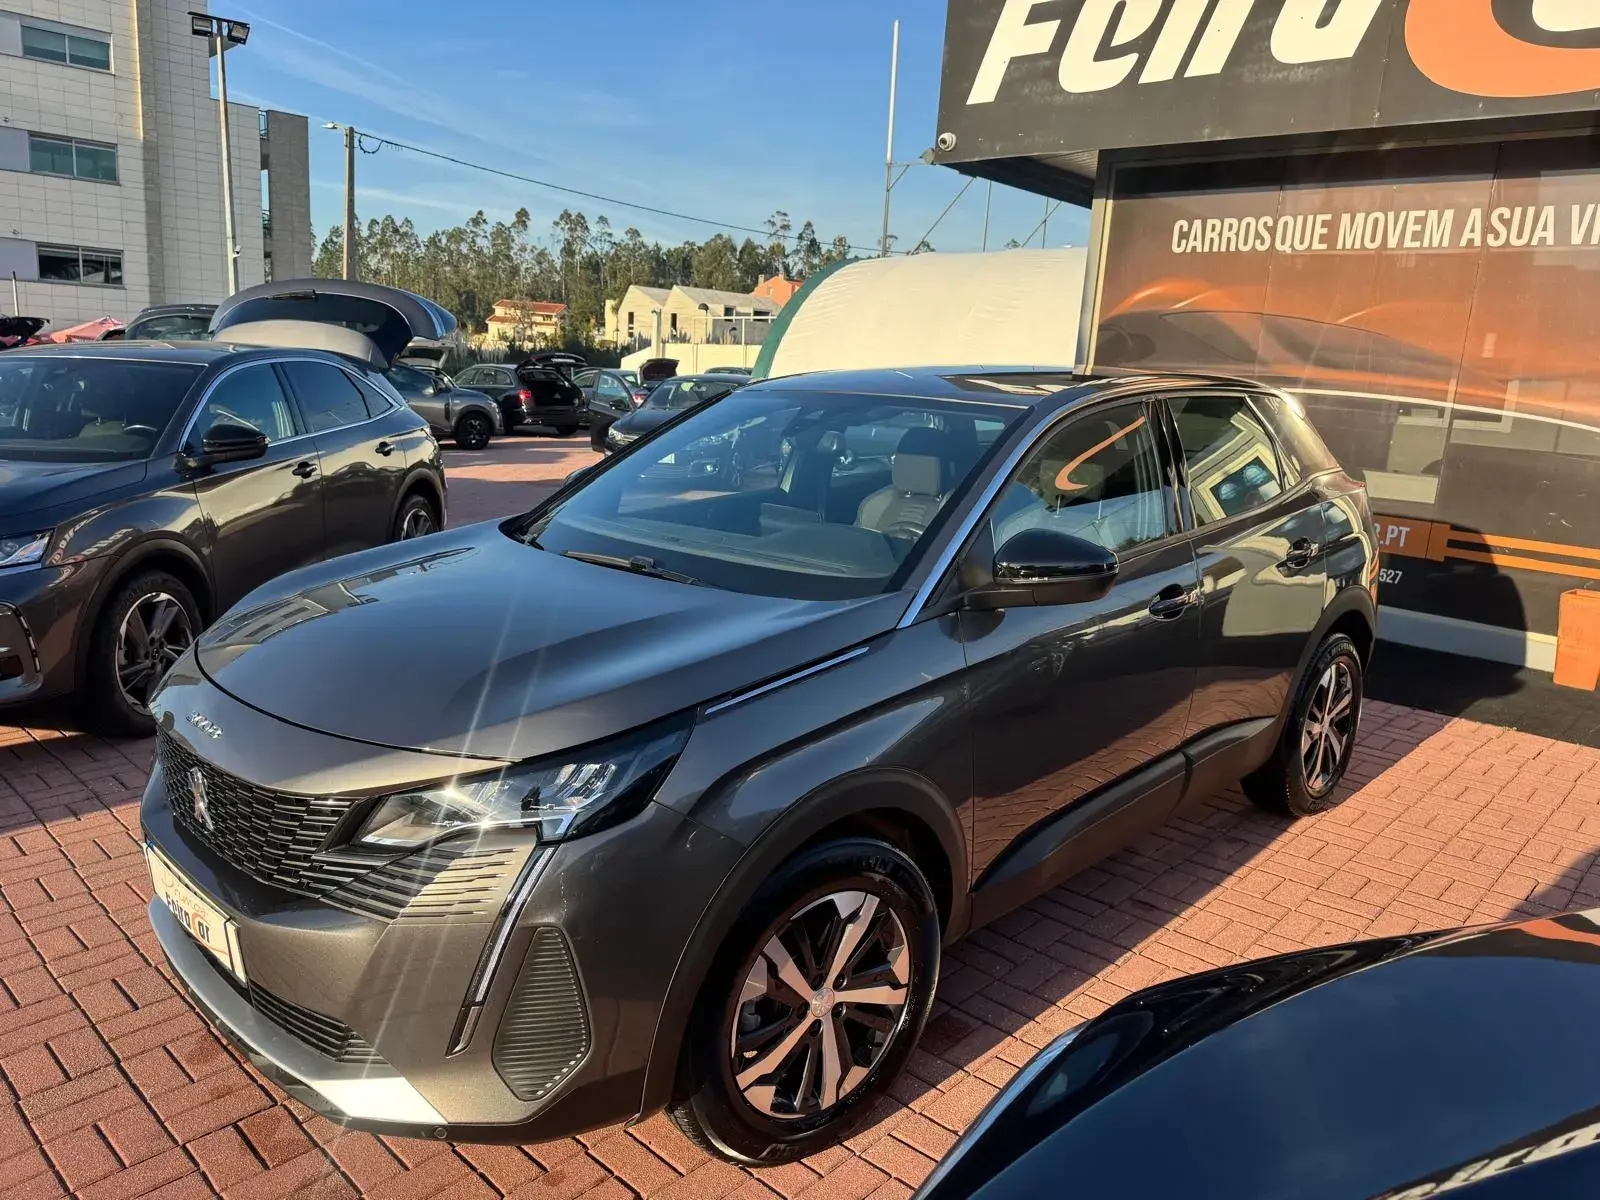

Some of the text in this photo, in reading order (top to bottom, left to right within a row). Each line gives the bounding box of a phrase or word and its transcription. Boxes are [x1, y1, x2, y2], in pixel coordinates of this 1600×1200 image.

[1171, 215, 1274, 254] CARROS
[1274, 213, 1332, 254] QUE
[1336, 208, 1455, 250] MOVEM
[1459, 207, 1482, 248] A
[1486, 205, 1556, 247] SUA
